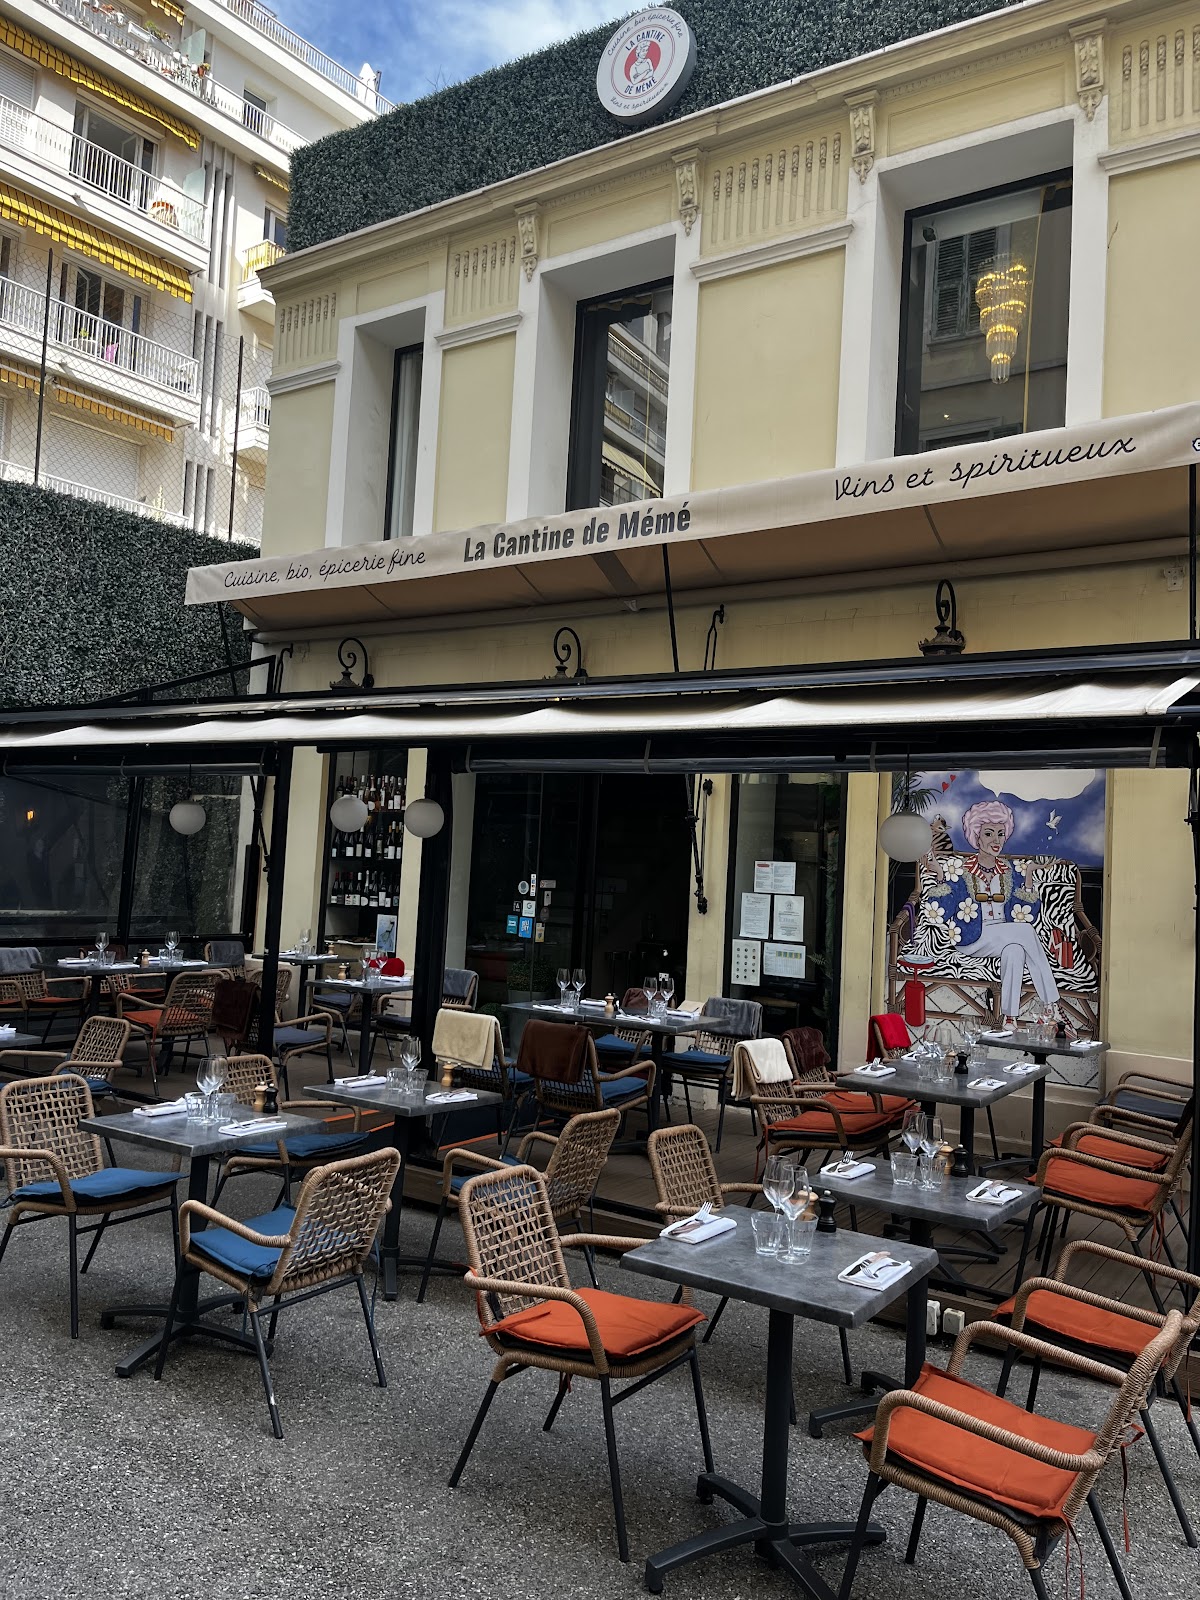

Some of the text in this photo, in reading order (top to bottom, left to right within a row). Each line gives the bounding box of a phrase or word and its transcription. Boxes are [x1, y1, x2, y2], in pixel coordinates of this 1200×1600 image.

[625, 29, 666, 51] LA CANTINE
[624, 84, 634, 95] DE
[834, 437, 1137, 501] Vins et spiritueux
[463, 501, 691, 563] La Cantine de Mémé
[224, 548, 426, 588] Cuisine, bio, épicerie fine
